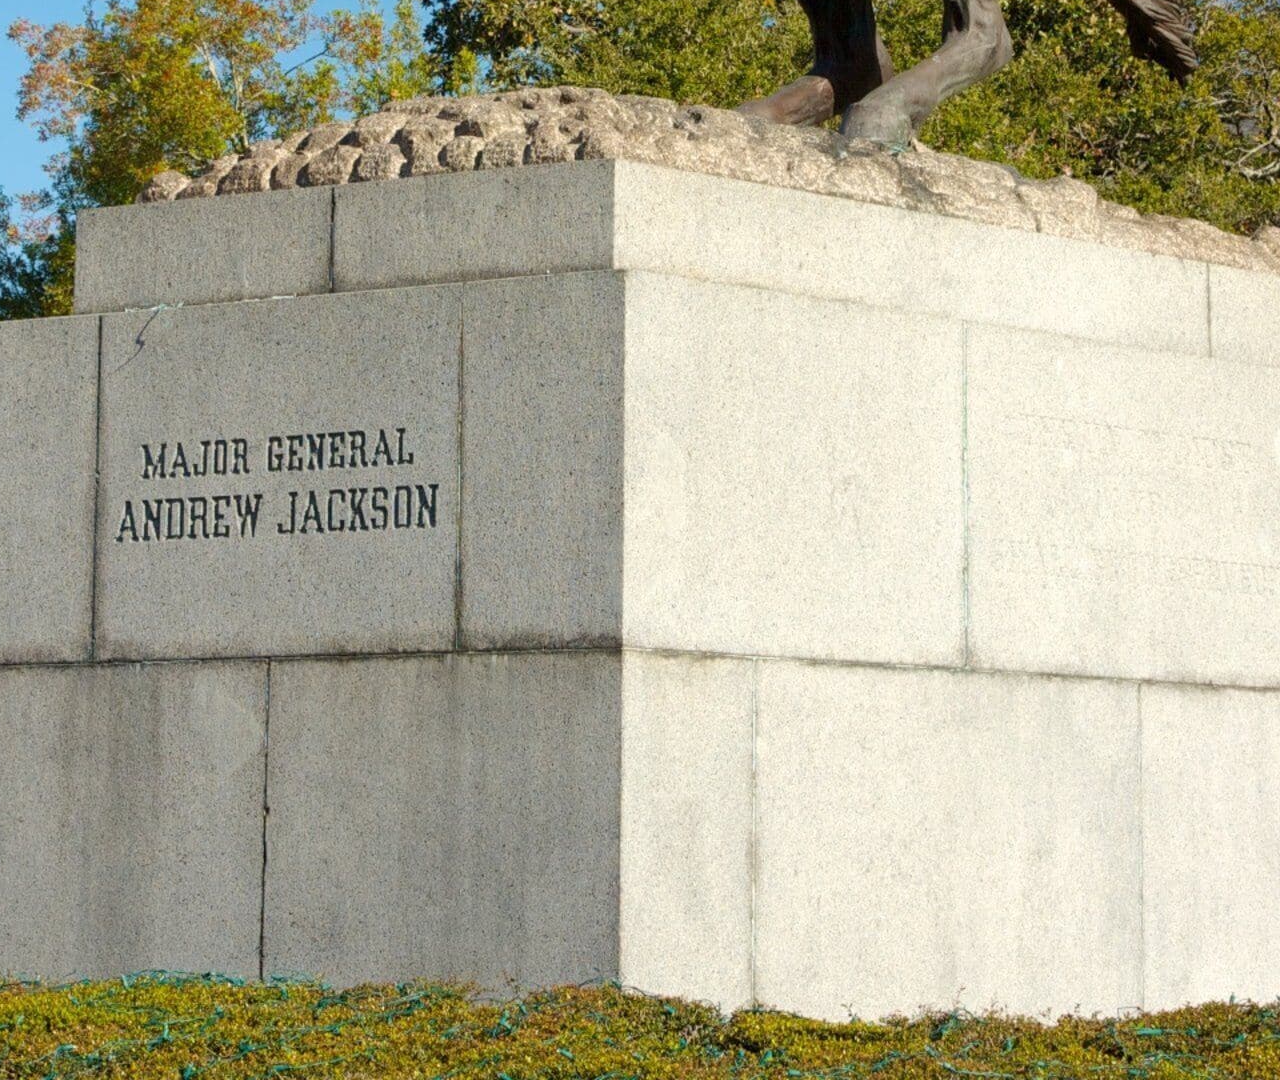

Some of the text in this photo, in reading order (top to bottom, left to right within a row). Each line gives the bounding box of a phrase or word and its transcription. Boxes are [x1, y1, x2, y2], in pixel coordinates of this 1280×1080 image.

[141, 427, 414, 479] MAJOR GENERAL
[115, 483, 439, 542] ANDREW JACKSON
